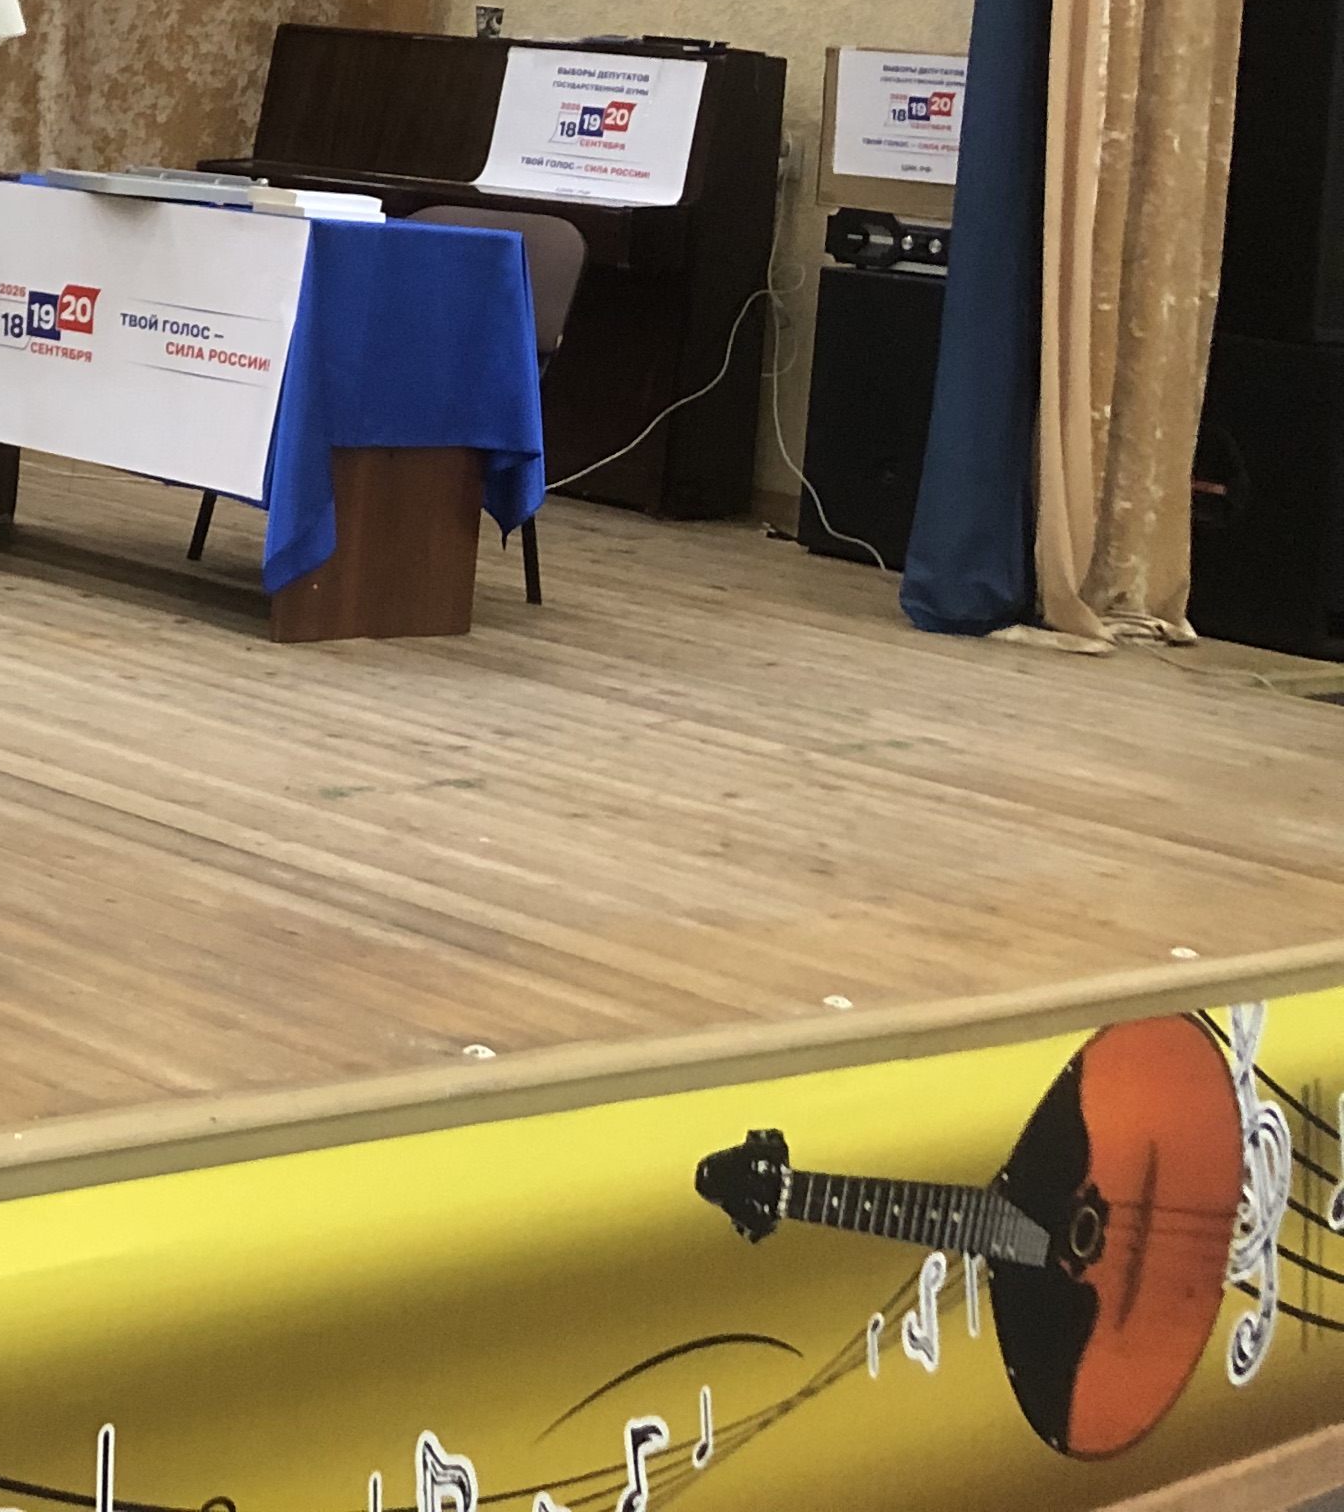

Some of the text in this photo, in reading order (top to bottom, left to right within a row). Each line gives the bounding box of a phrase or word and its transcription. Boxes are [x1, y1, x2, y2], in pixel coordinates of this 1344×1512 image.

[557, 66, 650, 82] ВЫБОРЫ ДЕПУТАТОВ
[552, 80, 649, 96] ГОСУДАРСТВЕННОЙ ДУМЫ
[892, 97, 951, 121] 18 19 20
[560, 109, 628, 137] 18 19 20
[579, 139, 626, 150] СЕНТЯБРЯ
[521, 156, 544, 166] ТВОЙ
[545, 159, 575, 170] ГОЛОС
[584, 164, 608, 174] СИЛА
[610, 167, 650, 179] РОССИИ!
[0, 283, 26, 298] 2026
[1, 295, 92, 338] 18 19 20
[120, 313, 158, 331] ТВОЙ
[162, 320, 210, 339] ГОЛОС
[30, 342, 92, 363] СЕНТЯБРЯ
[166, 341, 271, 372] СИЛА РОССИИ!
